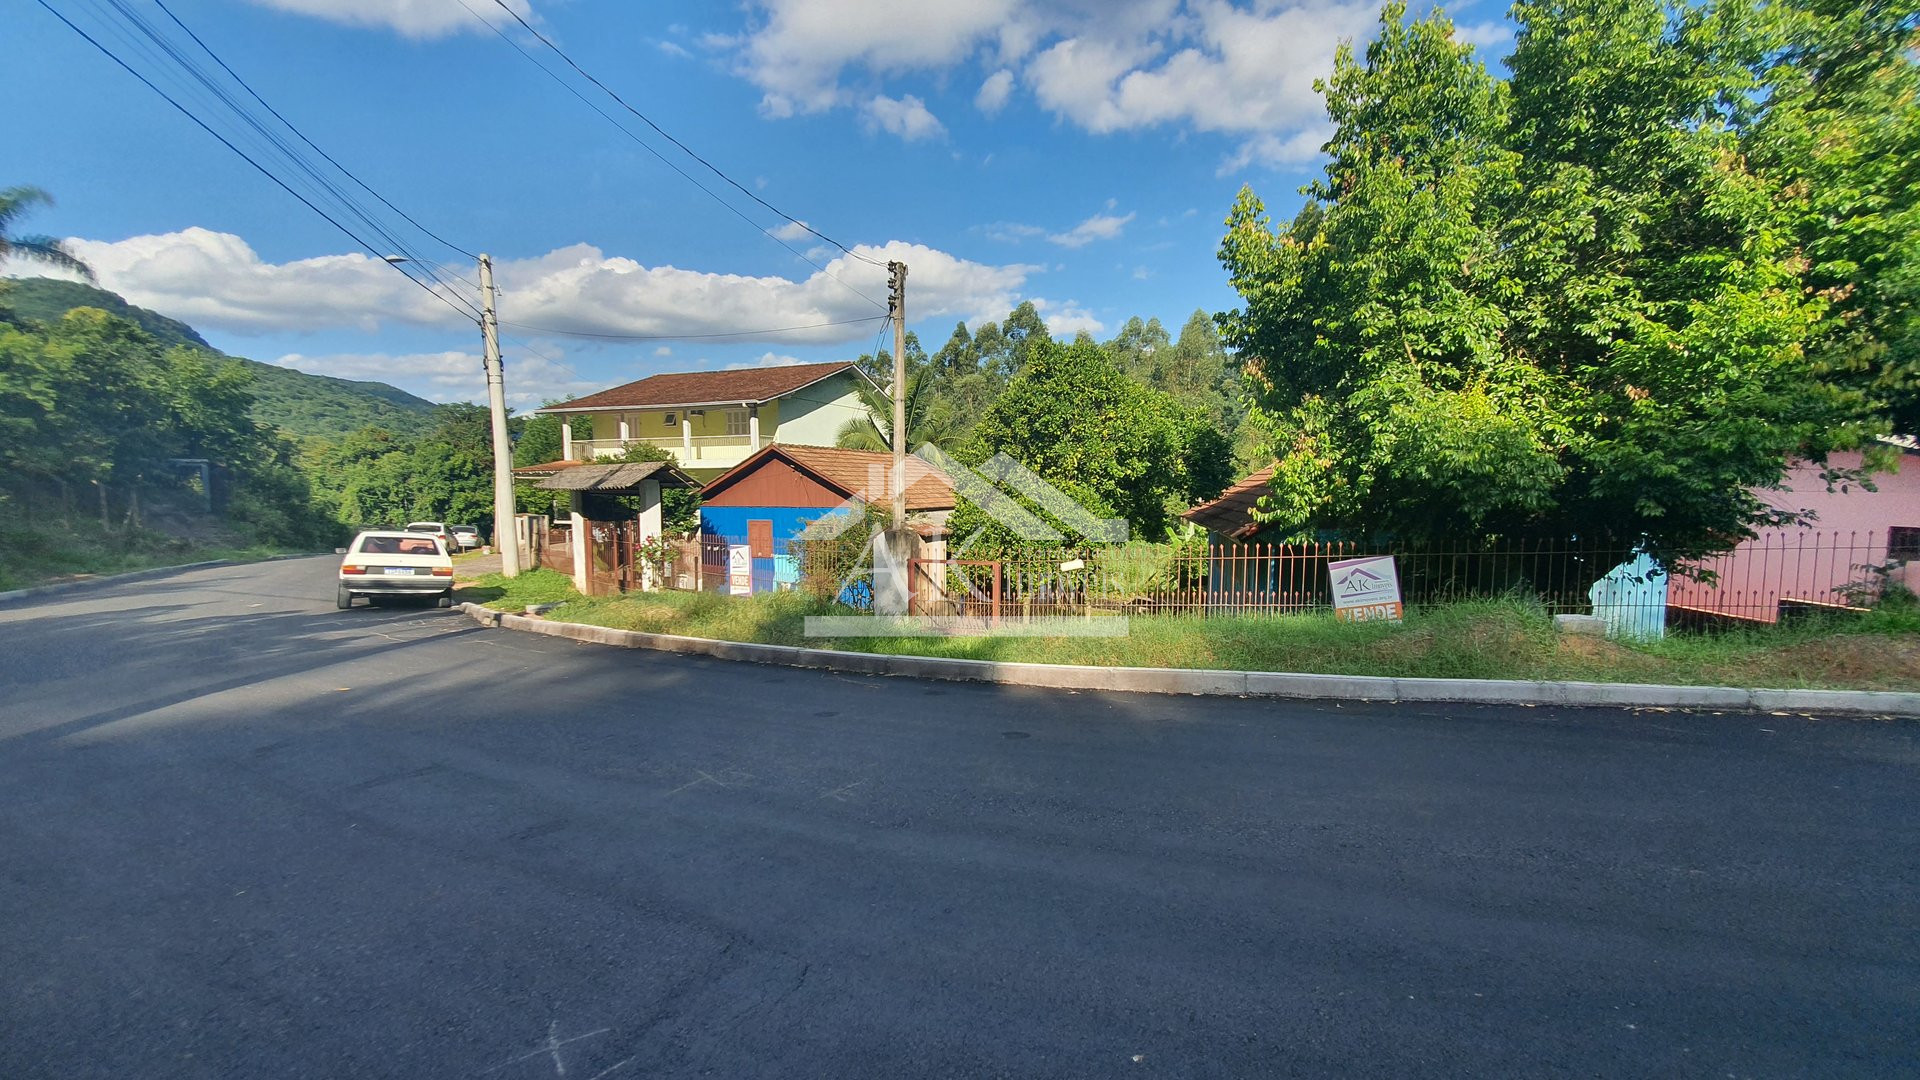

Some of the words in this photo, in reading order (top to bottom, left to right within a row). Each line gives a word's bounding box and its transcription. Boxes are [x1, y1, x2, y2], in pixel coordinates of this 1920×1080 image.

[731, 575, 749, 586] VENDE
[1345, 578, 1371, 592] AK
[1341, 603, 1398, 622] VENDE
